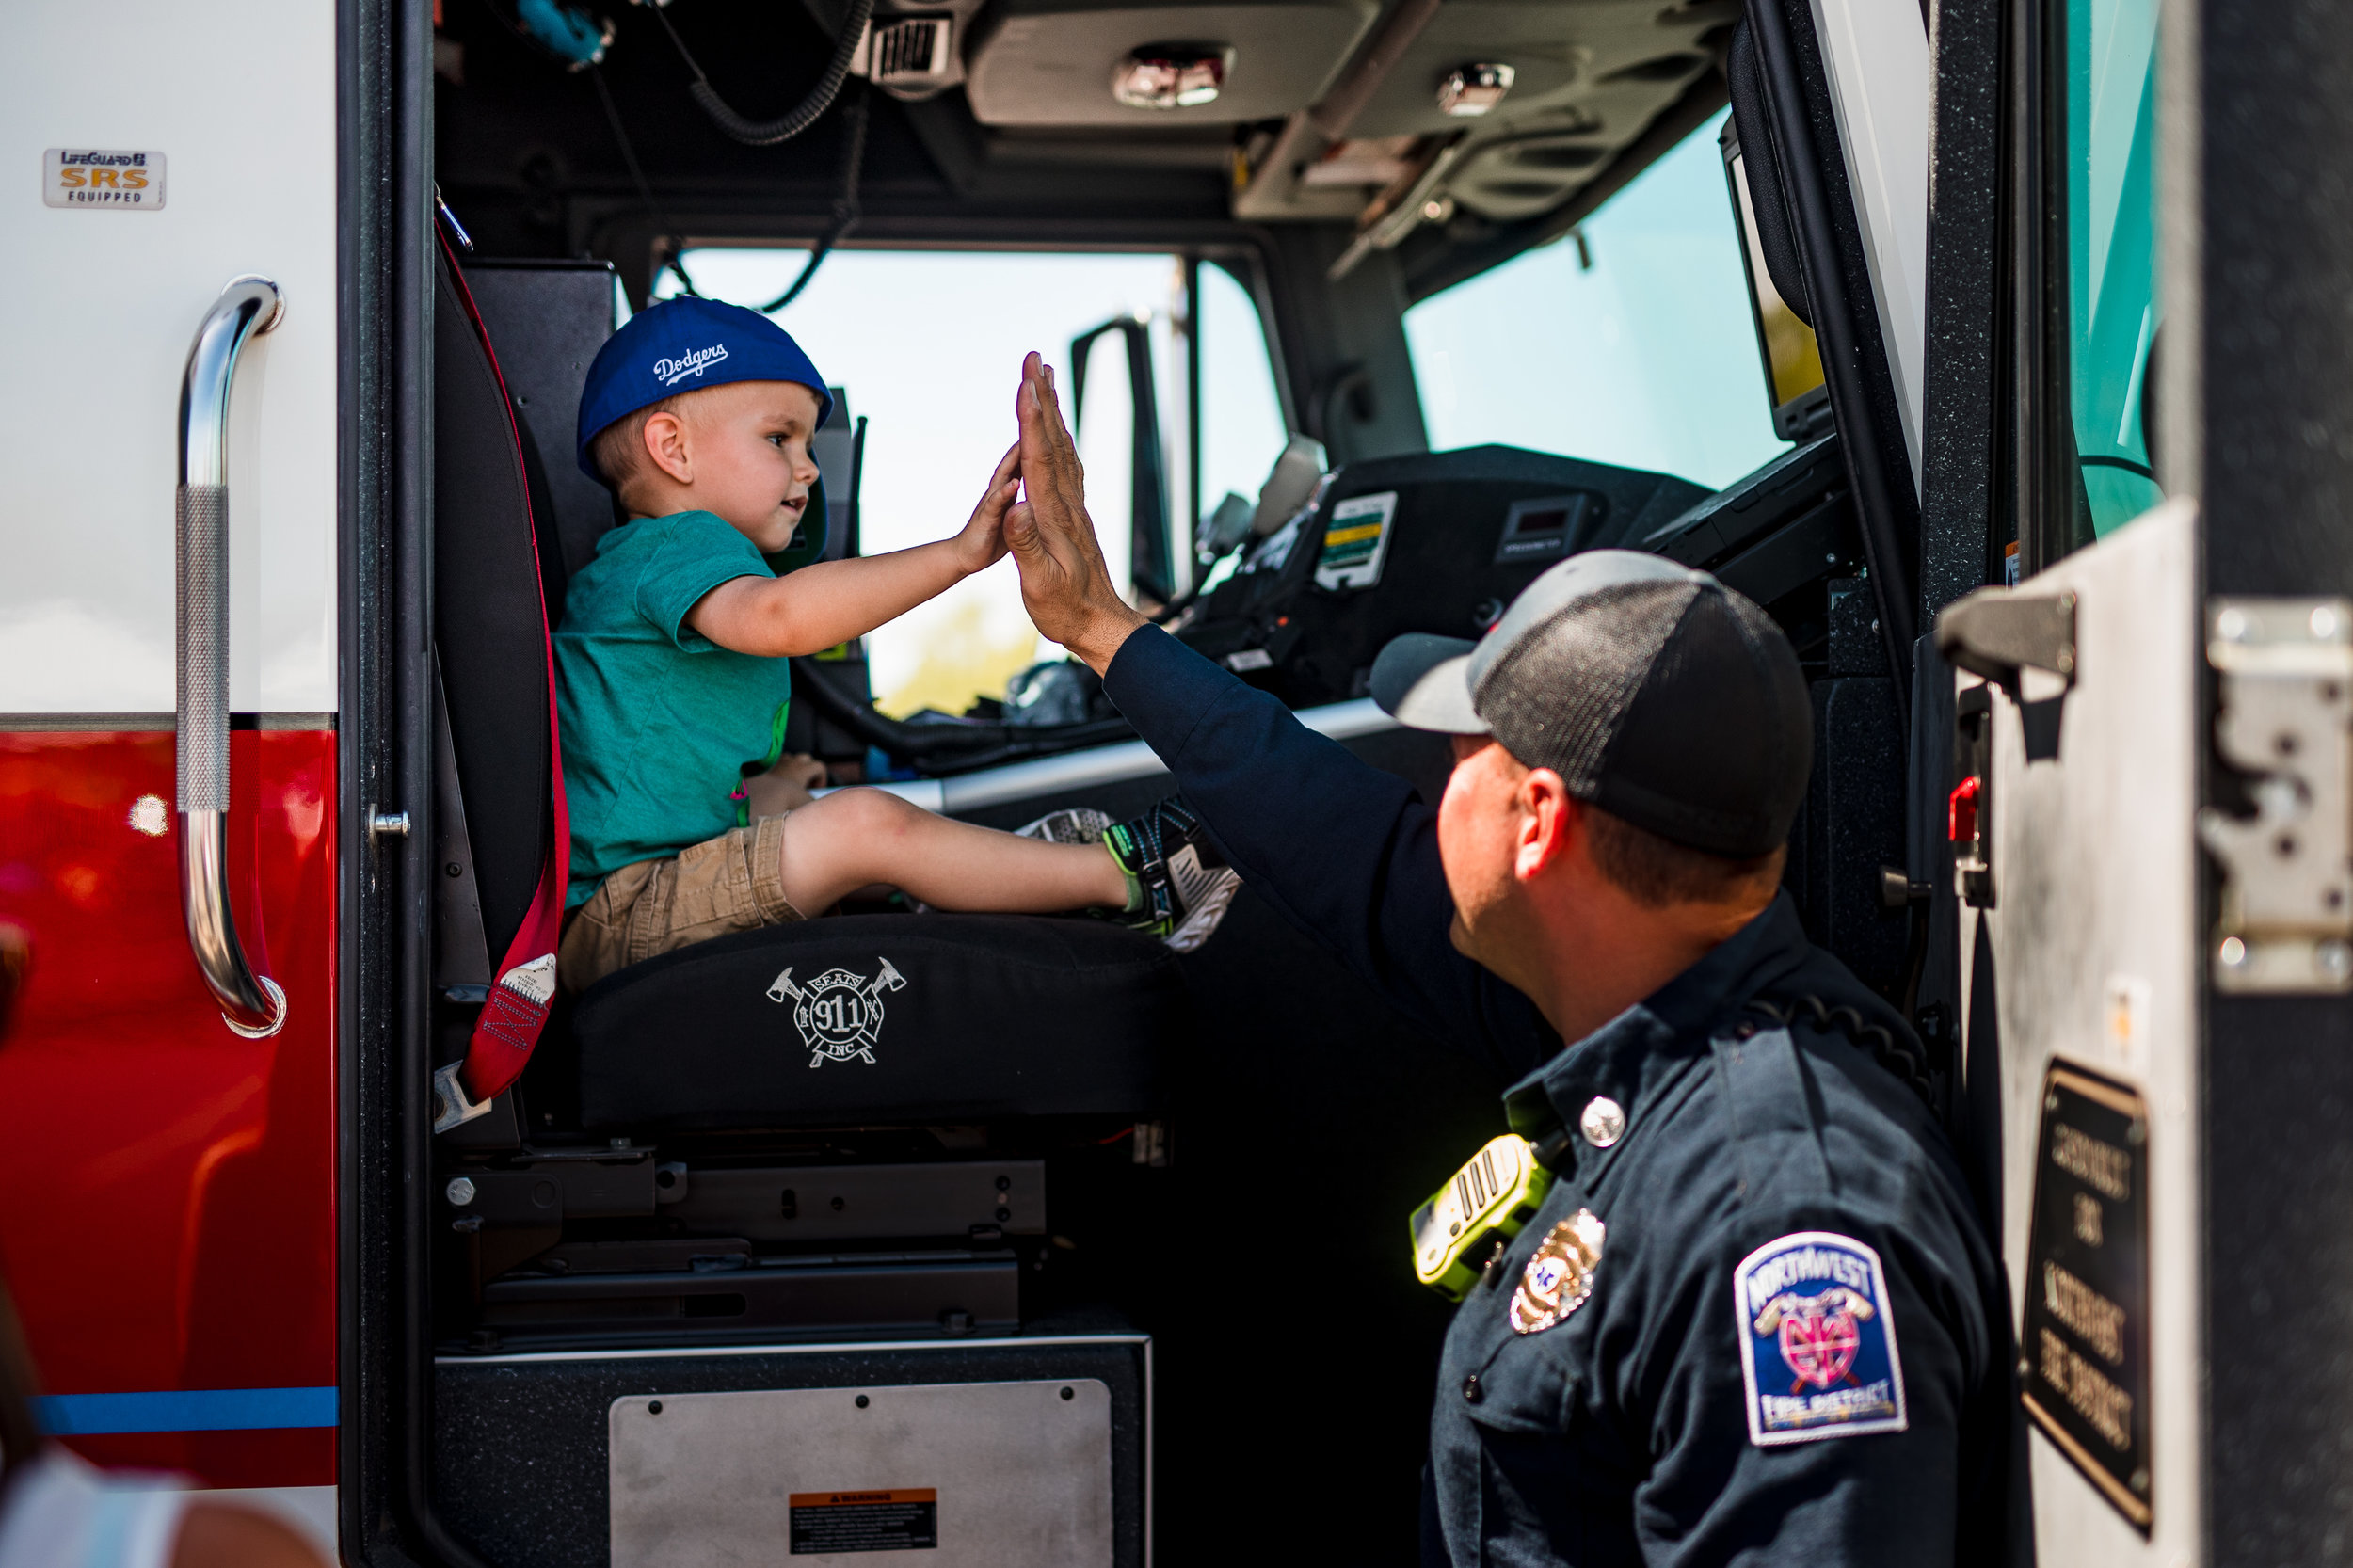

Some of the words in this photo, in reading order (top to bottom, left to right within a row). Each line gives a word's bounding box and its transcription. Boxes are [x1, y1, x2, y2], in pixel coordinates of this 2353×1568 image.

[60, 168, 149, 189] SRS
[69, 191, 141, 202] EQUIPPED
[653, 344, 728, 387] Dodgers
[814, 973, 860, 989] SEATS
[813, 994, 863, 1033] 911
[827, 1044, 855, 1056] INC
[1748, 1247, 1871, 1311] NORTHWEST
